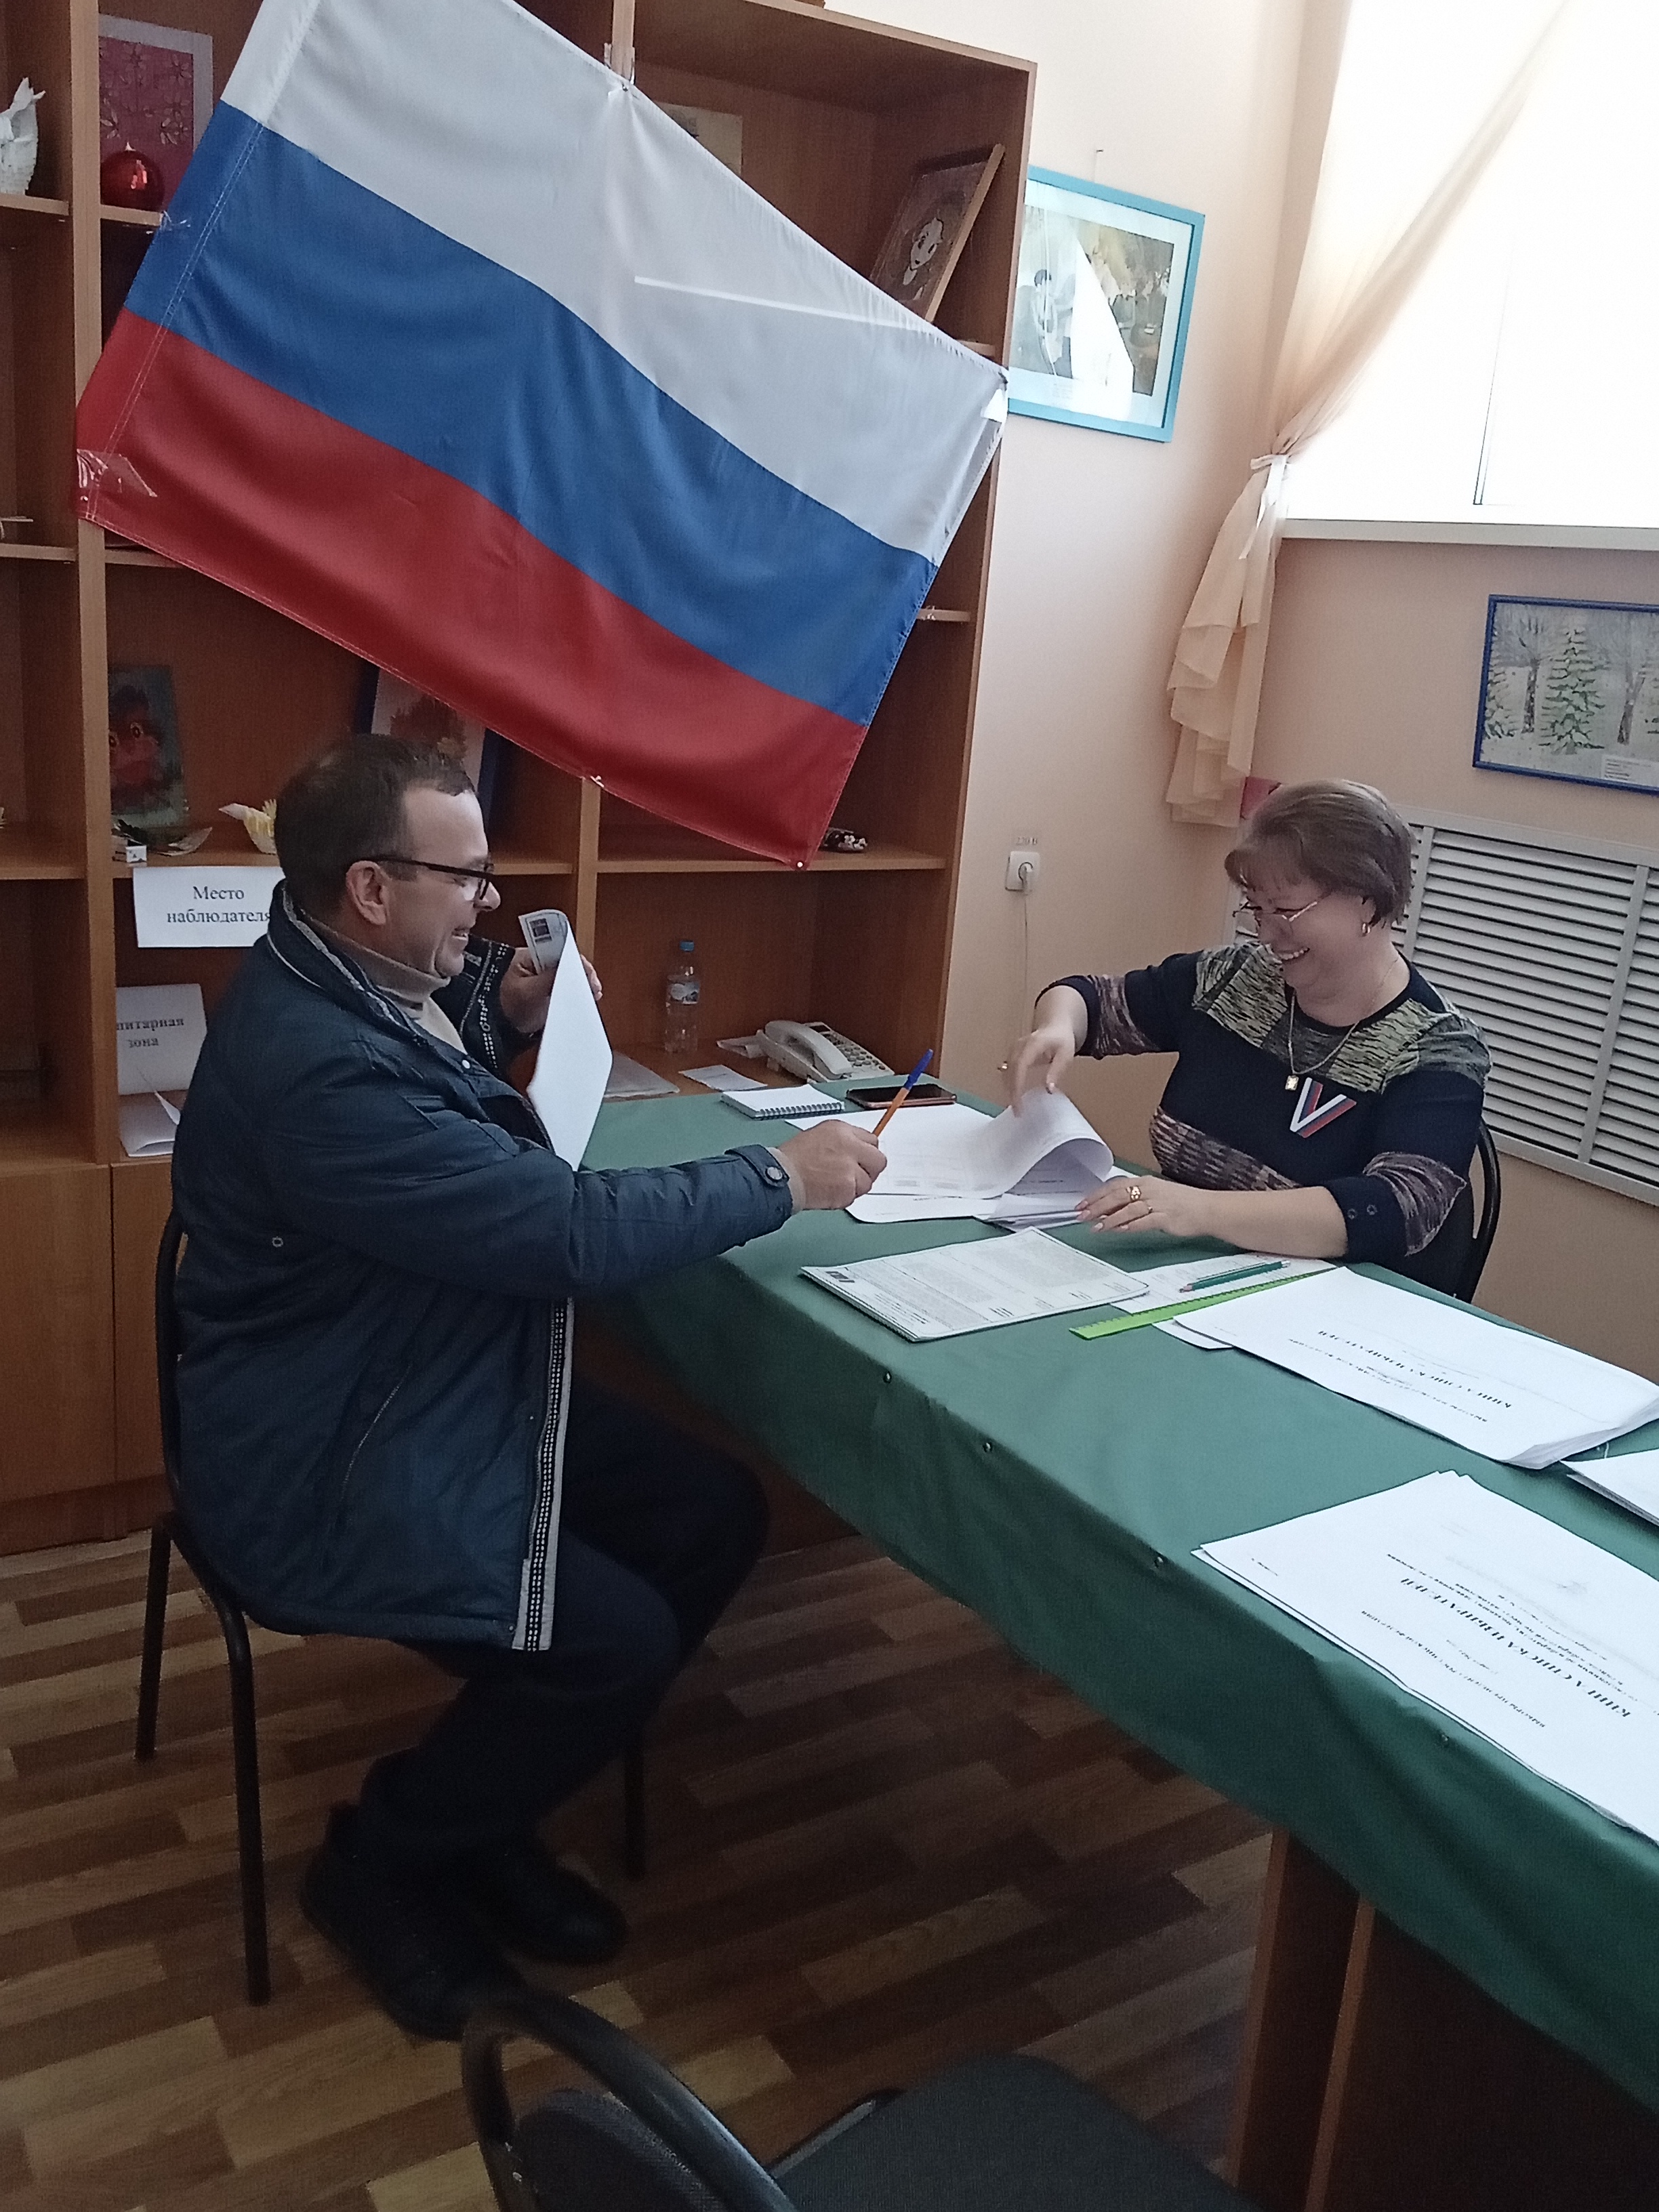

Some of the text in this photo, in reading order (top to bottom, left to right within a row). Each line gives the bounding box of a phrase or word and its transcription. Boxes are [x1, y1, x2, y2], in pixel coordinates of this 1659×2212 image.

[192, 886, 245, 900] Место
[167, 908, 271, 923] наблюдателя
[126, 1038, 159, 1048] зона
